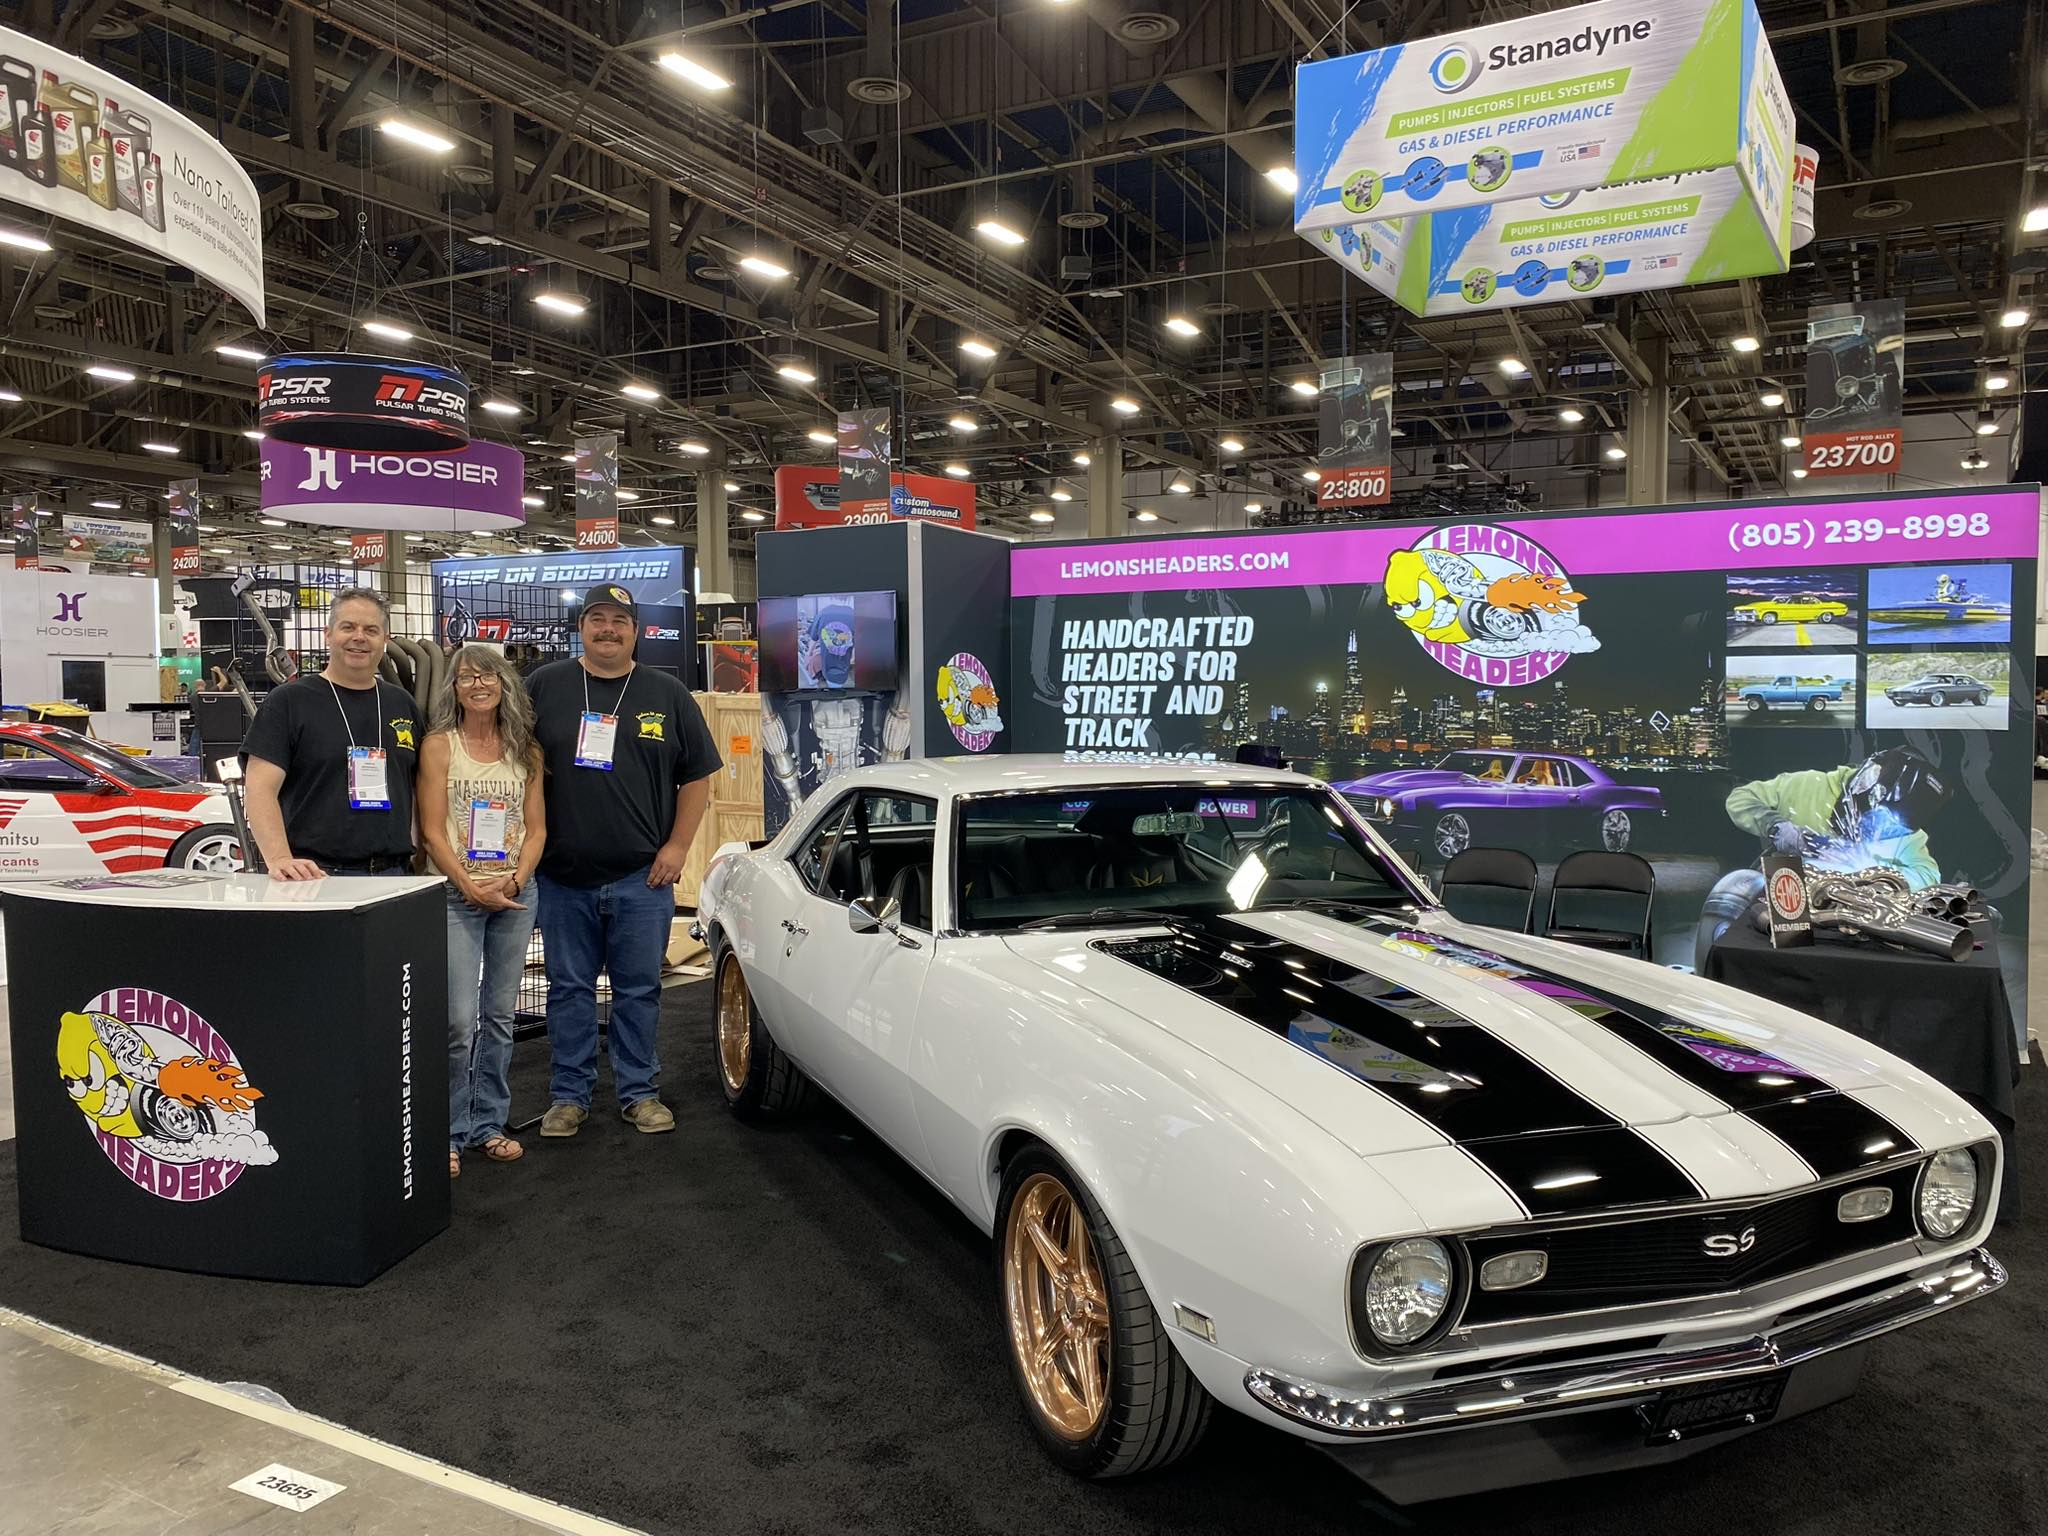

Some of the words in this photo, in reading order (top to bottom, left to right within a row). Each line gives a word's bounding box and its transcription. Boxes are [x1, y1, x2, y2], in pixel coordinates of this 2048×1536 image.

[1489, 19, 1651, 70] Stanadyne
[1398, 112, 1439, 130] PUMPS
[1448, 98, 1514, 120] INJECTORS
[1523, 91, 1554, 106] FUEL
[1557, 78, 1615, 99] SYSTEMS
[1399, 140, 1426, 154] GAS
[1429, 138, 1439, 149] &
[1443, 125, 1493, 146] DIESEL
[1497, 102, 1615, 137] PERFORMANCE
[1560, 154, 1576, 163] USA
[173, 151, 212, 197] Nano
[216, 179, 249, 232] Tailored
[173, 191, 191, 210] Over
[1510, 224, 1545, 236] PUMPS
[1552, 215, 1606, 232] INJECTORS
[1614, 212, 1640, 223] FUEL
[1642, 203, 1689, 219] SYSTEMS
[1510, 246, 1533, 257] GAS
[1535, 244, 1545, 254] &
[1547, 236, 1588, 253] DIESEL
[1592, 223, 1689, 247] PERFORMANCE
[1644, 263, 1658, 271] USA
[269, 377, 331, 397] PSR
[269, 399, 287, 407] TURBO
[290, 396, 331, 405] SYSTEMS
[376, 400, 414, 411] PULSAR
[417, 404, 444, 416] TURBO
[417, 387, 466, 415] PSR
[1810, 442, 1896, 469] 23700
[351, 454, 498, 487] HOOSIER
[1322, 478, 1386, 500] 23800
[894, 495, 930, 508] custom
[910, 506, 960, 519] autosound
[844, 512, 889, 526] 23900
[89, 528, 148, 540] TREADPASS
[579, 530, 615, 546] 24000
[1728, 518, 1815, 553] (805)
[1824, 512, 1991, 543] 239-8998
[173, 556, 199, 570] 24200
[353, 544, 384, 559] 24100
[1431, 525, 1556, 586] LEMONS
[504, 566, 537, 584] ON
[541, 560, 670, 582] BOOSTING!
[1061, 551, 1289, 579] LEMONSHEADERS.COM
[36, 626, 109, 638] HOOSIER
[657, 628, 680, 636] PSR
[1062, 615, 1255, 650] HANDCRAFTED
[1062, 651, 1176, 682] HEADERS
[1184, 650, 1238, 682] FOR
[1062, 685, 1158, 715] STREET
[1165, 684, 1224, 716] AND
[1064, 718, 1152, 748] TRACK
[1199, 801, 1249, 815] POWER
[1776, 876, 1801, 913] SEMA
[1774, 922, 1811, 932] MEMBER
[100, 988, 234, 1065] LEMONS
[400, 962, 413, 1200] LEMONSHEADERS.COM
[1703, 1226, 1755, 1257] SS
[256, 1476, 318, 1500] 23655
